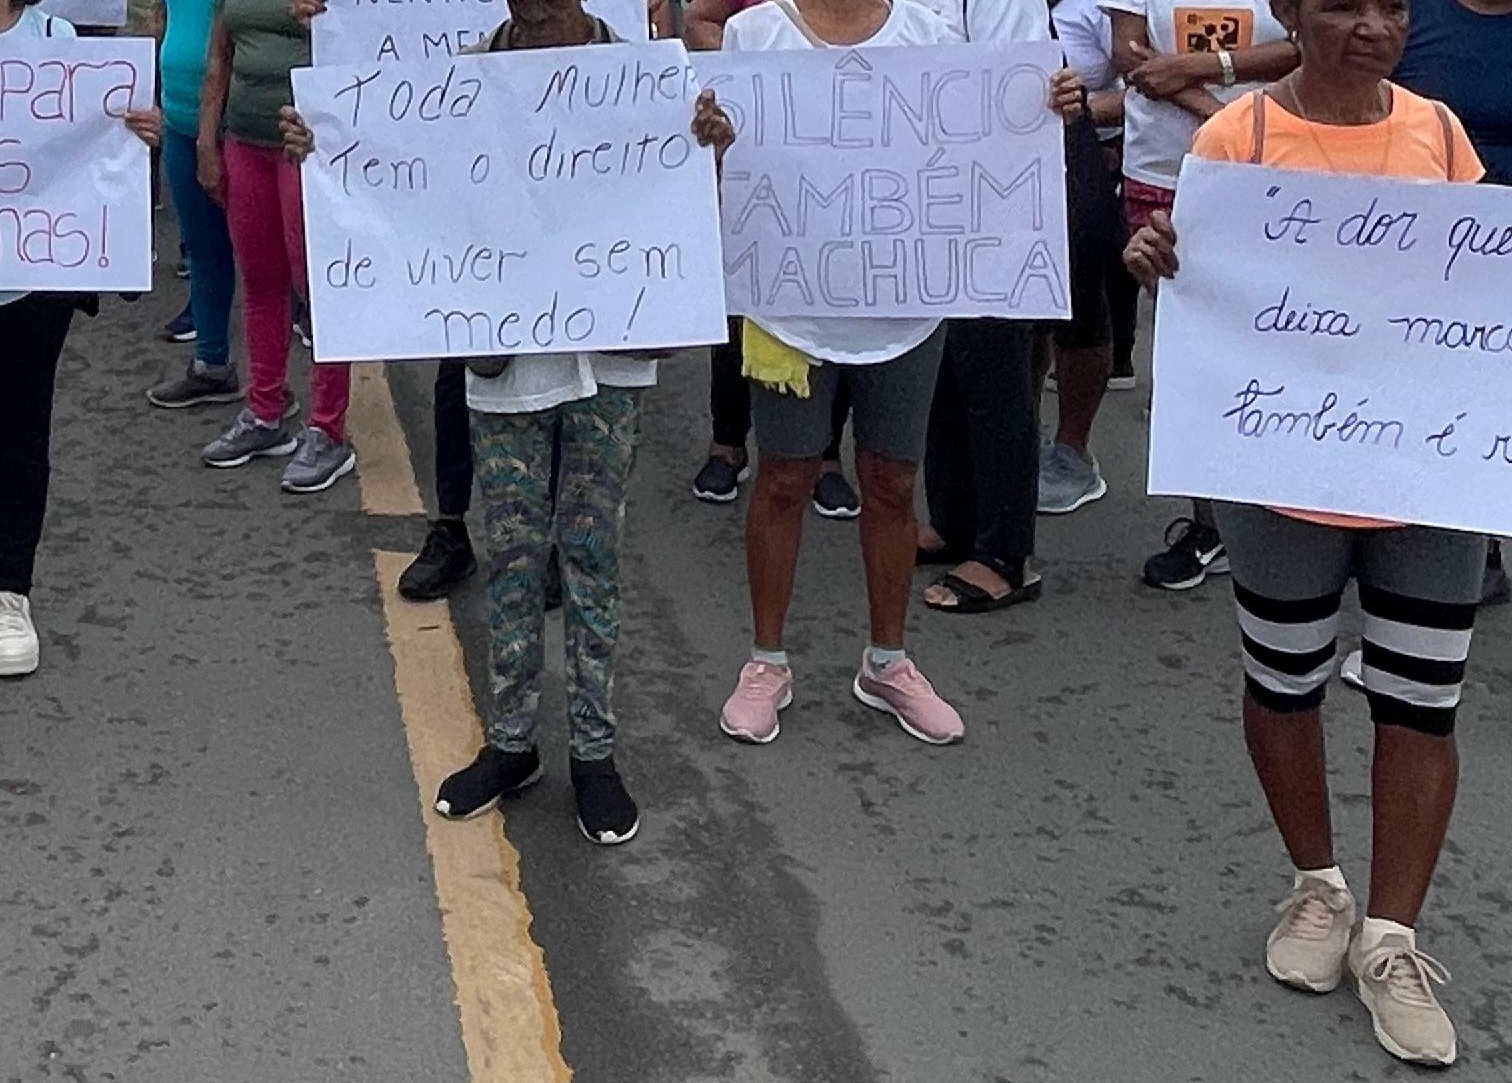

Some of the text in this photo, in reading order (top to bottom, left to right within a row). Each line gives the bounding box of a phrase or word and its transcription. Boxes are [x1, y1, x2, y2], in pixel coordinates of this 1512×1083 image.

[376, 33, 401, 62] A
[334, 63, 486, 128] Toda
[328, 127, 690, 197] Tem o direito
[1336, 196, 1420, 251] dor
[326, 237, 687, 289] de viver sem
[1254, 286, 1362, 338] deixa
[1222, 378, 1512, 465] também é r
